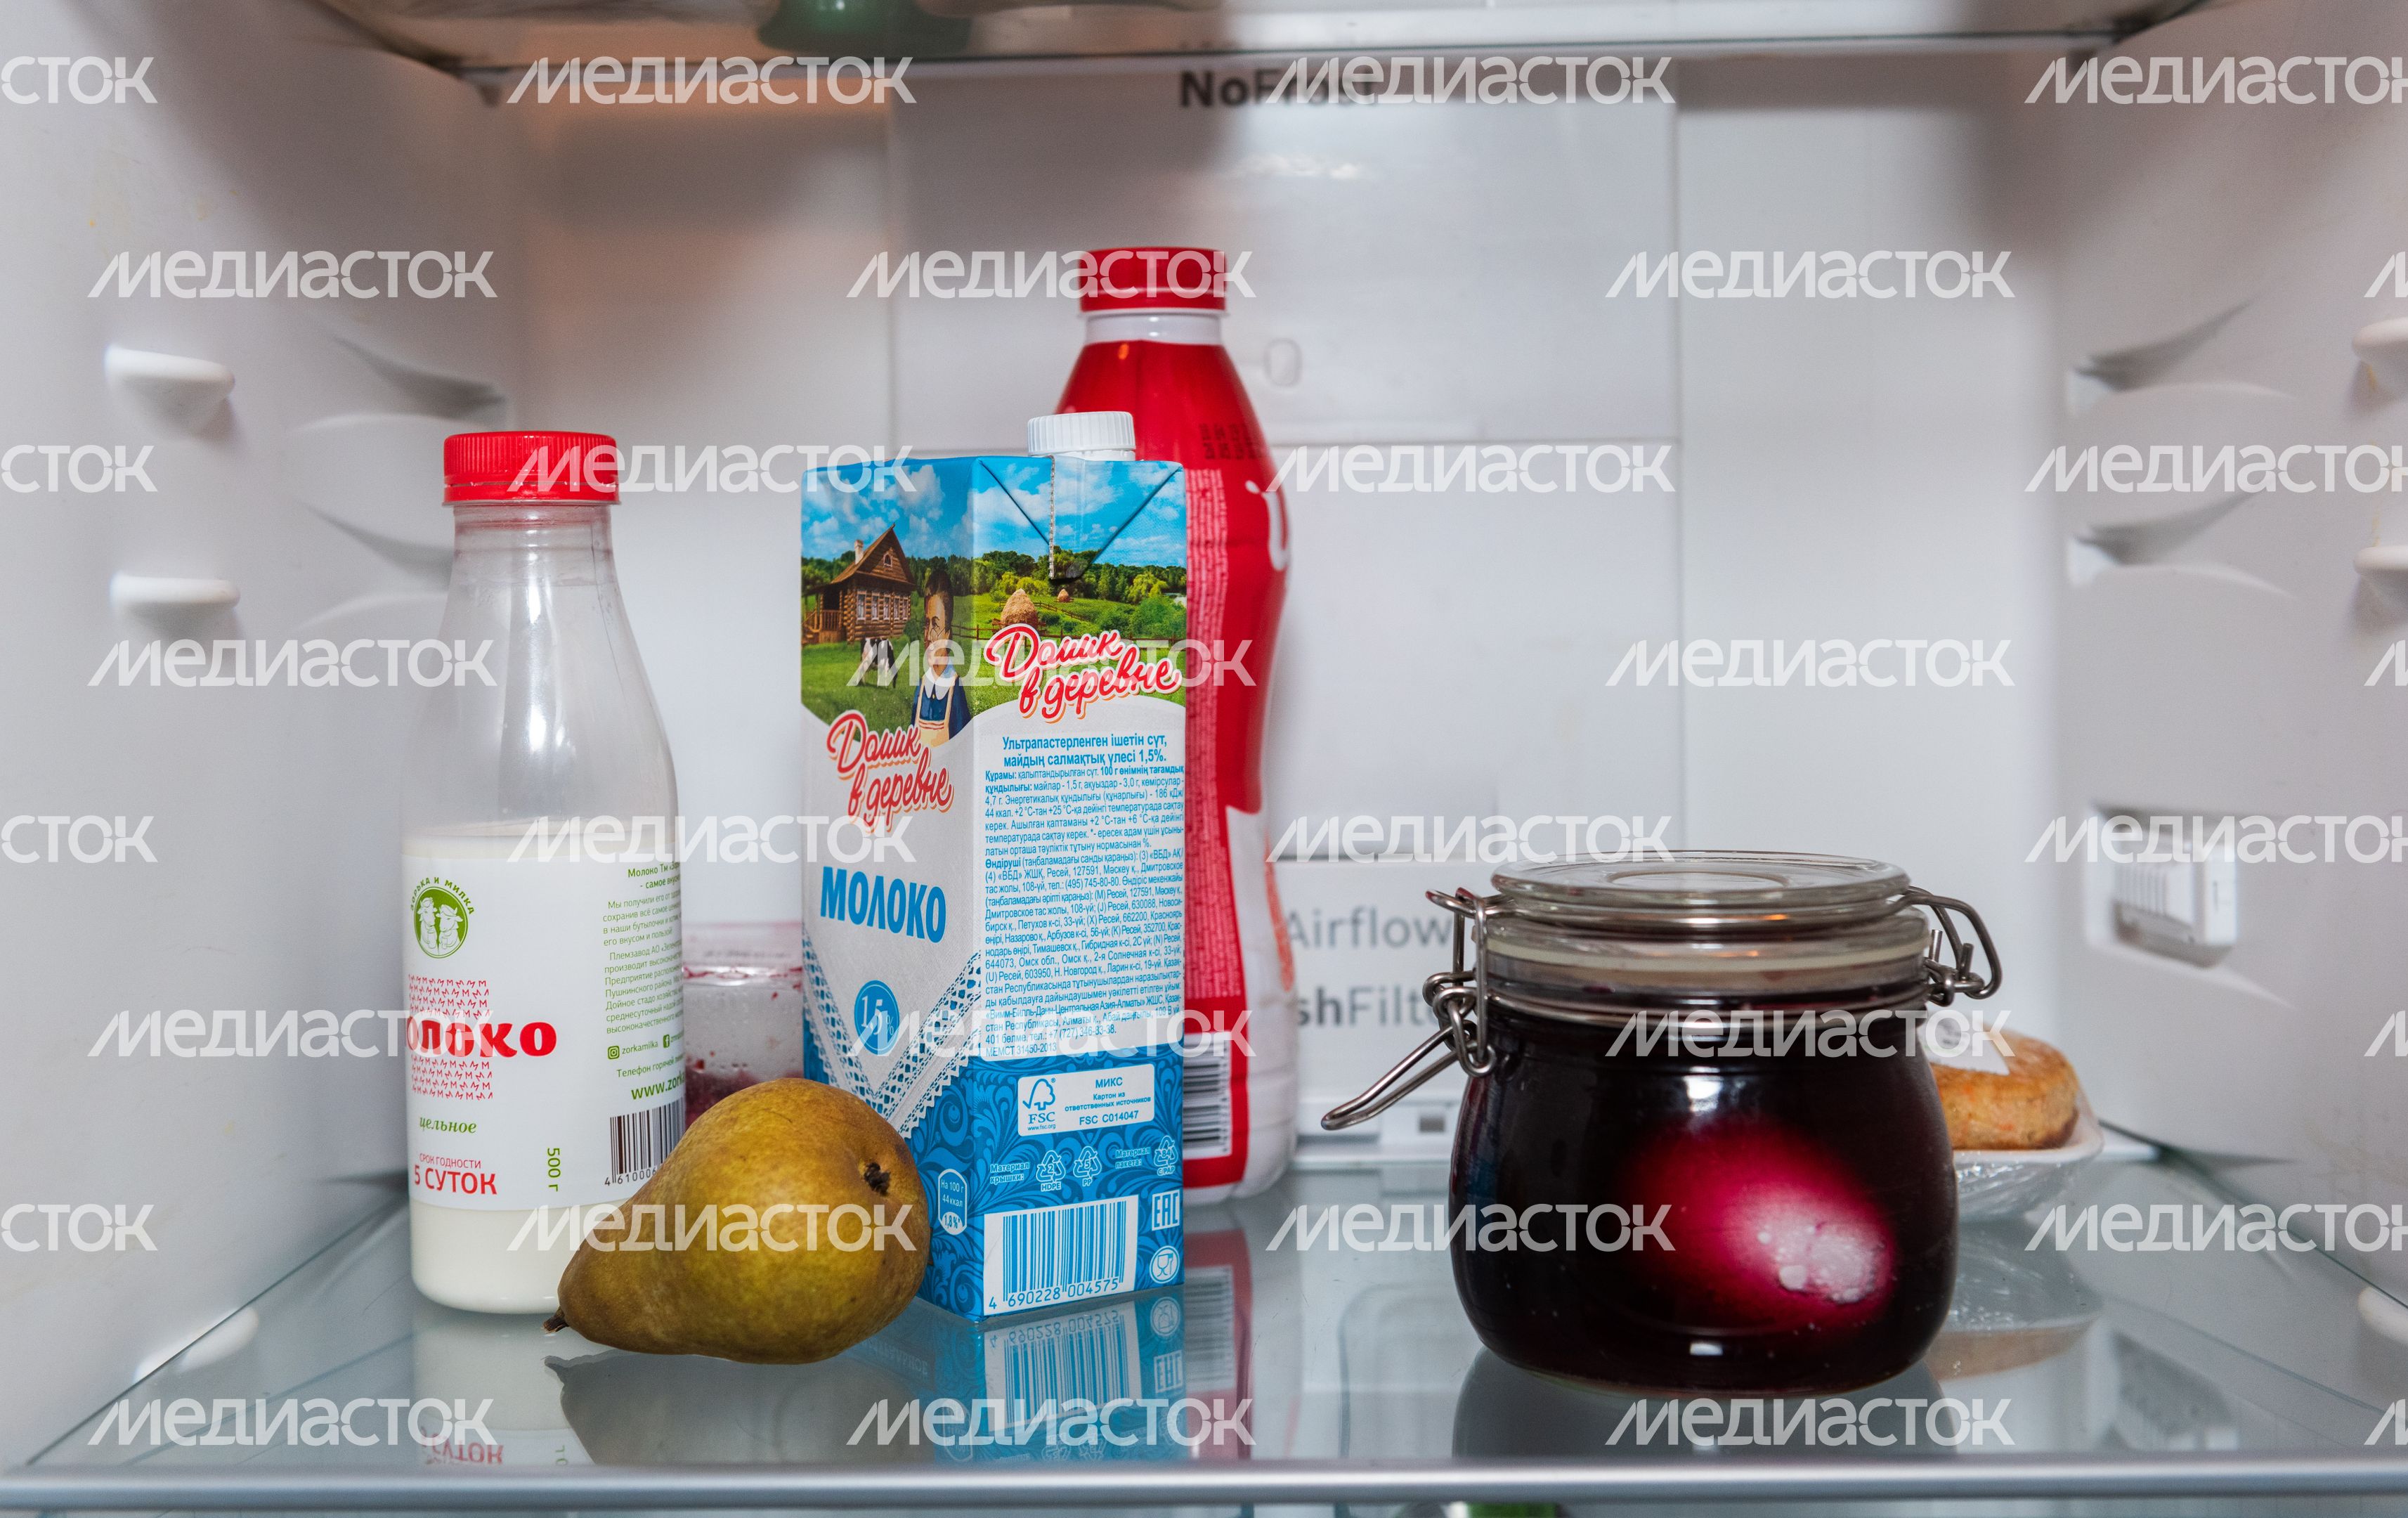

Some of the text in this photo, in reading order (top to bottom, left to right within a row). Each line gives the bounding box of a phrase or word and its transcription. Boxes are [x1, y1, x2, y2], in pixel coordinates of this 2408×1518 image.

[985, 624, 1124, 680] Домик
[1019, 645, 1183, 720] в деревне
[826, 711, 923, 774] Домик
[1003, 733, 1166, 752] Ультрапастерленген ішетін сүт,
[1004, 748, 1166, 769] майдың салмақтық үлесі 1,5%.
[985, 770, 1017, 782] Құрамы:
[1018, 769, 1085, 780] қалыптандырылған
[1100, 766, 1113, 776] 100
[1119, 765, 1148, 778] өнімнің
[1149, 765, 1184, 774] тағамдық
[847, 748, 954, 830] в деревне
[985, 784, 1032, 795] құндылығы:
[1034, 781, 1061, 792] майлар
[1067, 779, 1076, 791] 1,5
[1084, 780, 1118, 791] ақуыздар
[1123, 777, 1134, 788] 3,0
[1142, 778, 1180, 789] көмірсулар
[985, 796, 996, 806] 4,7
[1005, 795, 1059, 805] Энергетикалық
[1061, 793, 1101, 804] құндылығы
[1103, 789, 1147, 802] (құнарлығы)
[1155, 788, 1167, 798] 186
[985, 808, 994, 818] 44
[1015, 807, 1023, 817] +2
[1048, 805, 1062, 815] +25
[1107, 803, 1162, 815] температурада
[985, 856, 1021, 869] Өндіруші
[1022, 855, 1079, 868] (таңбаламадағы
[1081, 855, 1103, 864] санды
[1139, 850, 1148, 862] (3)
[627, 867, 658, 878] Молоко
[646, 878, 666, 888] самое
[410, 877, 430, 911] ЗОРЬКА
[444, 879, 475, 914] МИЛКА
[608, 900, 621, 909] Мы
[624, 897, 654, 908] получили
[820, 866, 946, 944] МОЛОКО
[603, 912, 638, 922] сохранив
[611, 925, 631, 933] наши
[604, 938, 617, 947] его
[620, 935, 644, 945] вкусом
[610, 949, 650, 961] Племзавод
[604, 961, 647, 975] производит
[605, 973, 653, 986] Предприятие
[606, 985, 653, 999] Пушкинского
[606, 999, 635, 1011] Дойное
[637, 996, 655, 1004] стадо
[406, 1016, 557, 1058] олоко
[622, 1040, 658, 1054] zorkamilka
[617, 1065, 651, 1077] Телефон
[1095, 1077, 1123, 1088] МИКС
[1065, 1096, 1151, 1112] ответственных источников
[1028, 1112, 1055, 1124] FSC
[1079, 1110, 1139, 1125] FSC C014047
[419, 1116, 476, 1134] цельное
[1115, 1147, 1151, 1158] Материал
[419, 1153, 481, 1169] СРОК ГОДНОСТИ
[547, 1148, 561, 1179] 500
[990, 1162, 1030, 1173] Материал
[1115, 1159, 1142, 1169] пакета:
[1047, 1164, 1054, 1174] 2
[415, 1165, 497, 1195] 5 СУТОК
[604, 1177, 611, 1186] 4
[941, 1179, 948, 1190] На
[949, 1182, 960, 1193] 100
[990, 1174, 1024, 1185] крышки:
[1083, 1178, 1092, 1186] PP
[1041, 1183, 1061, 1192] HDPE
[942, 1194, 963, 1207] 44 ккал
[989, 1278, 1119, 1310] 4 690228 004575
